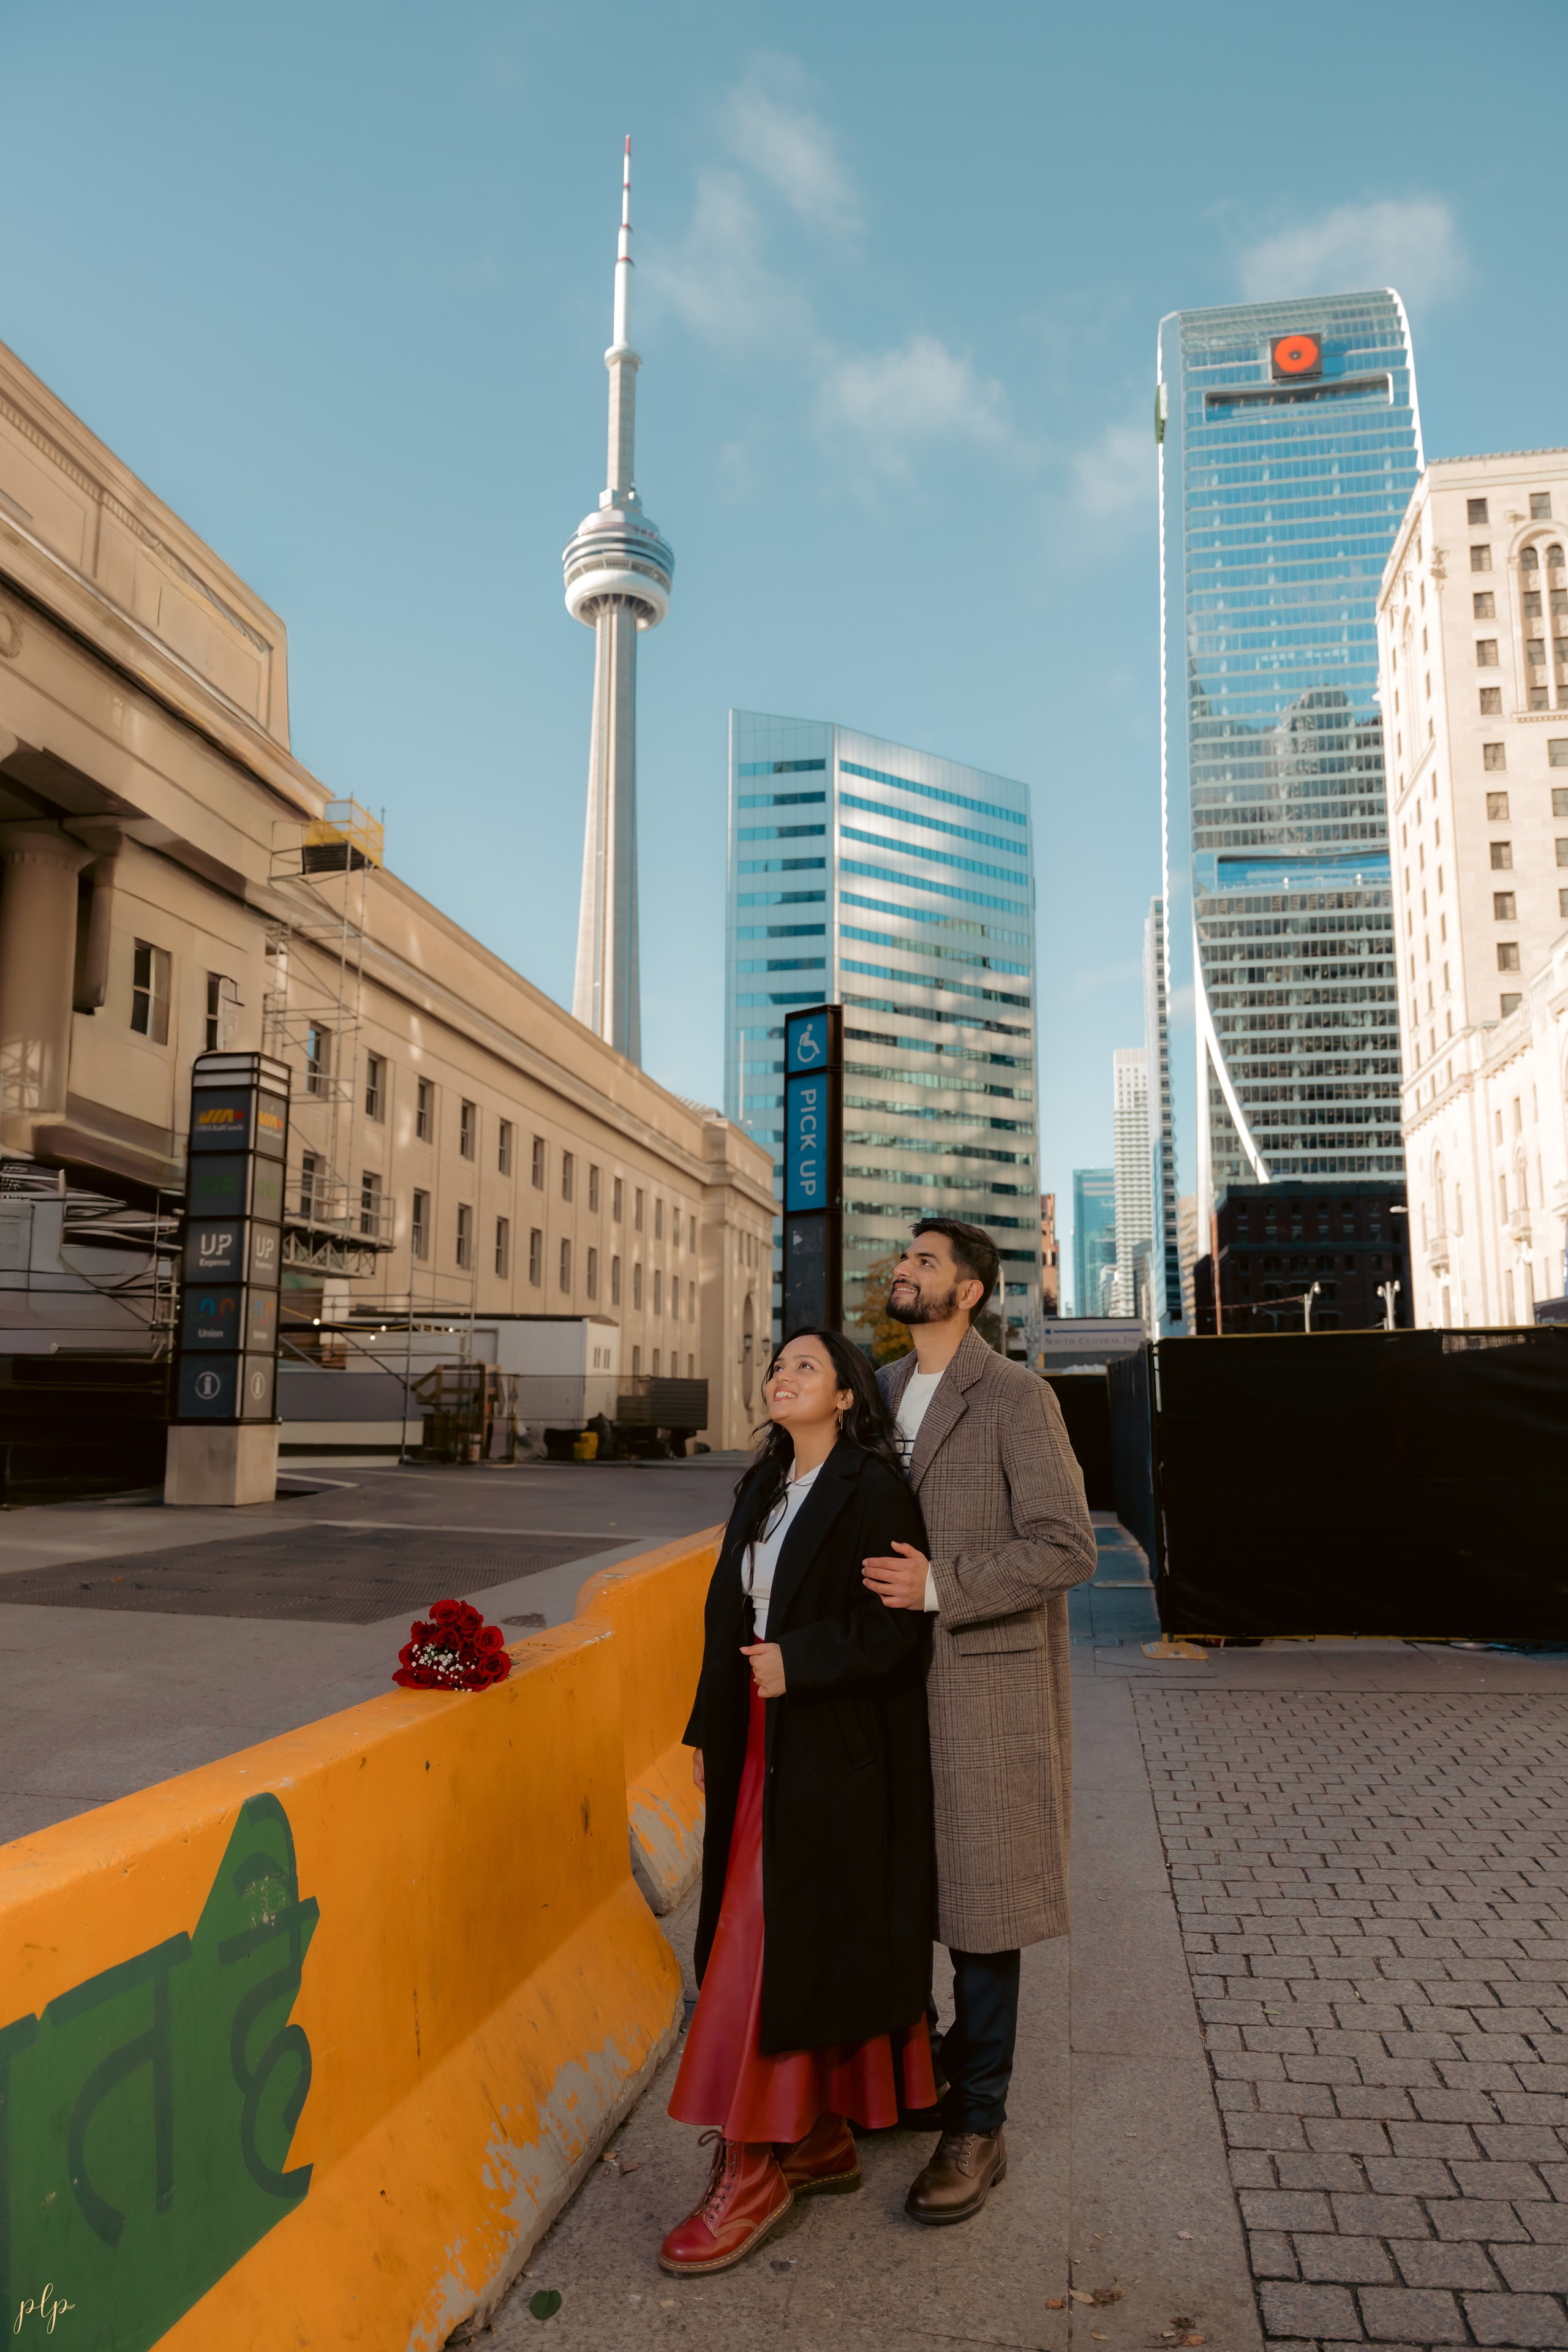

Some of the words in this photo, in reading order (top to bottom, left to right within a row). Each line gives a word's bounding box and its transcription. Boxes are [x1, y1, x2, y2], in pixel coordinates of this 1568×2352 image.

[199, 1109, 234, 1124] VIA
[800, 1088, 816, 1151] PICK
[799, 1159, 816, 1196] UP
[200, 1234, 233, 1256] UP
[256, 1235, 274, 1259] UP
[199, 1258, 231, 1268] Express
[198, 1329, 224, 1338] Union
